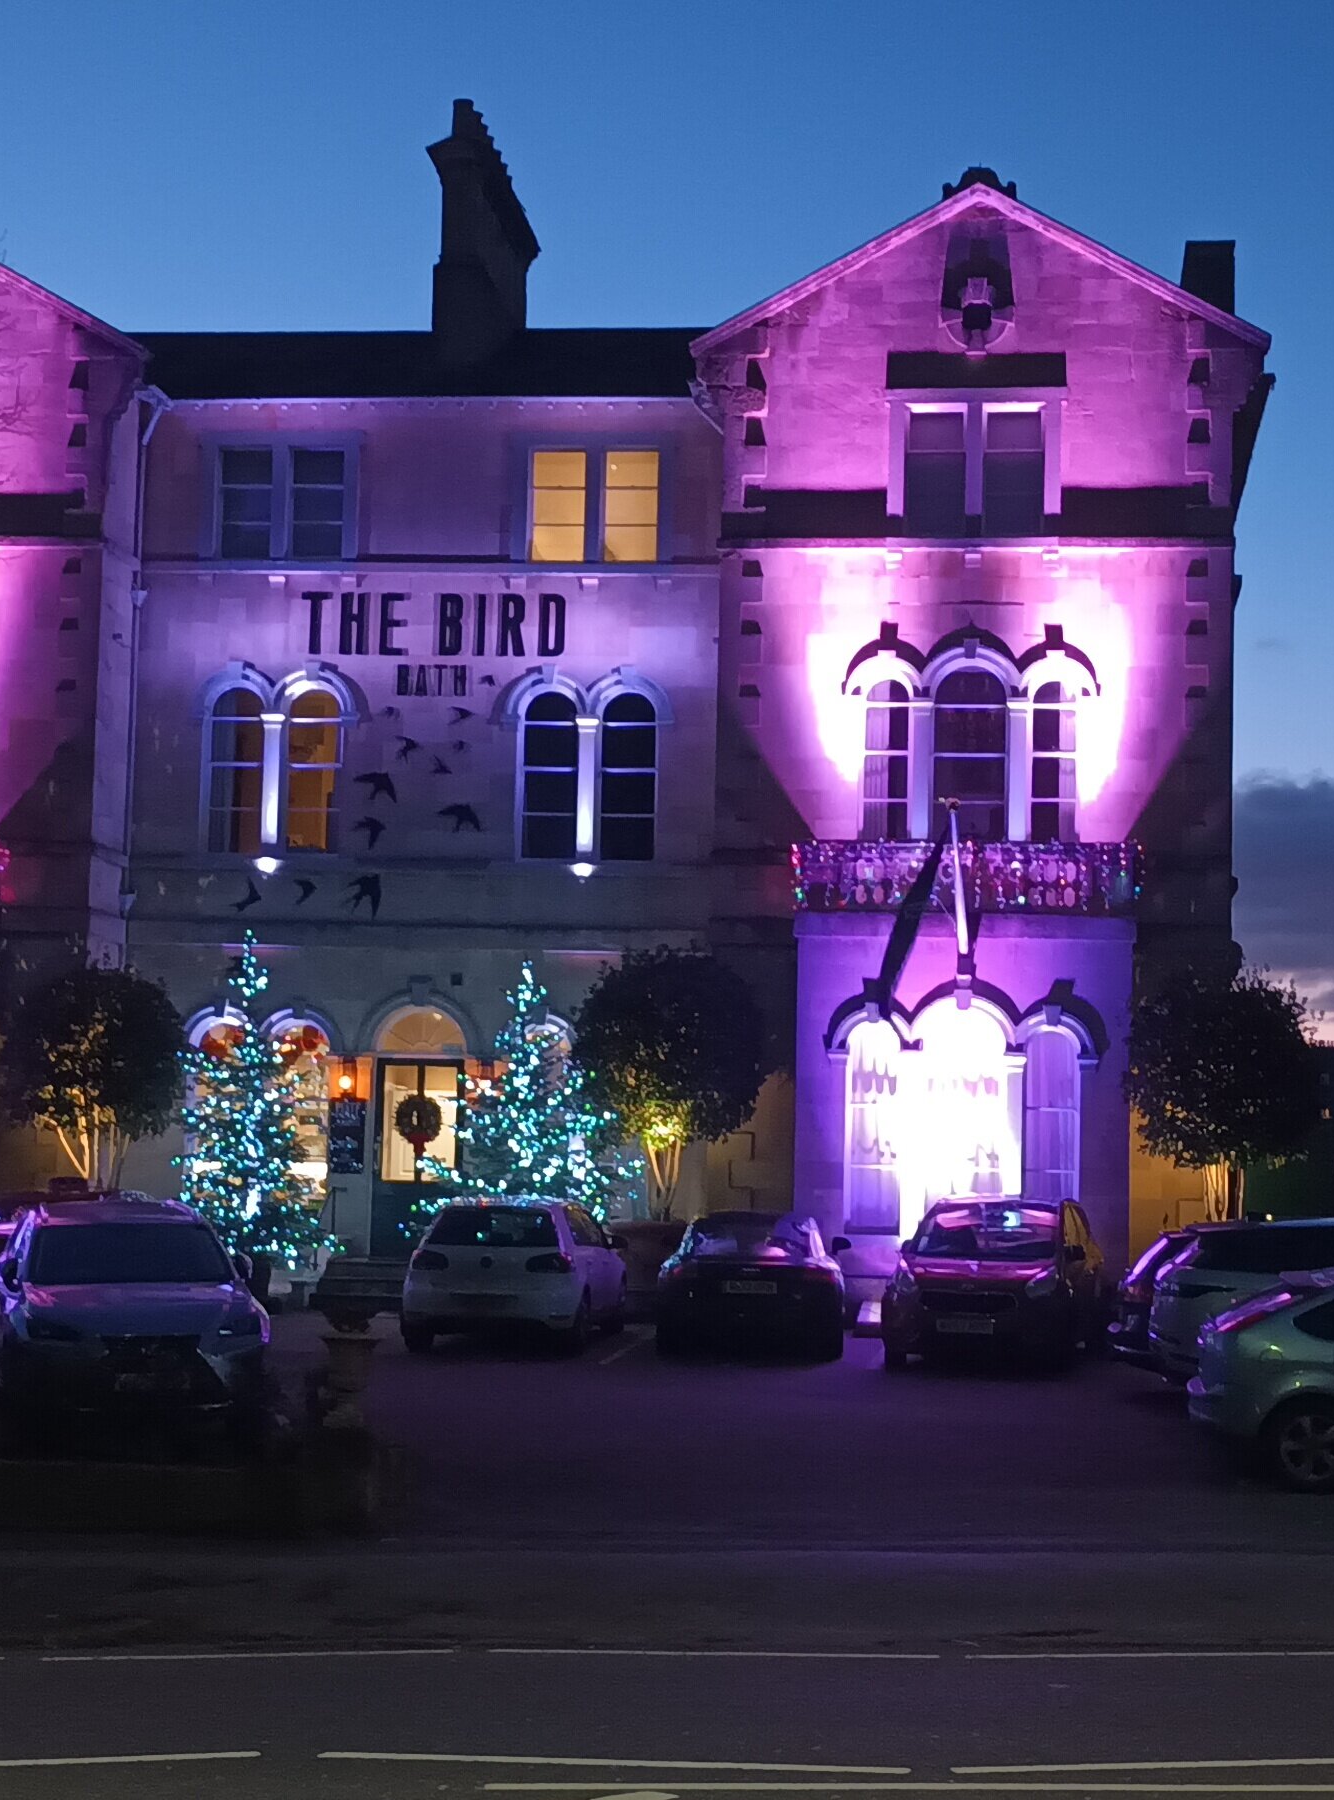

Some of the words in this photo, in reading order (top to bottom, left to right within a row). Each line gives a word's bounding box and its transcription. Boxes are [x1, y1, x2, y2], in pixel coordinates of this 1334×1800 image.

[301, 591, 410, 656] THE
[437, 592, 567, 657] BIRD
[396, 663, 468, 697] BATH
